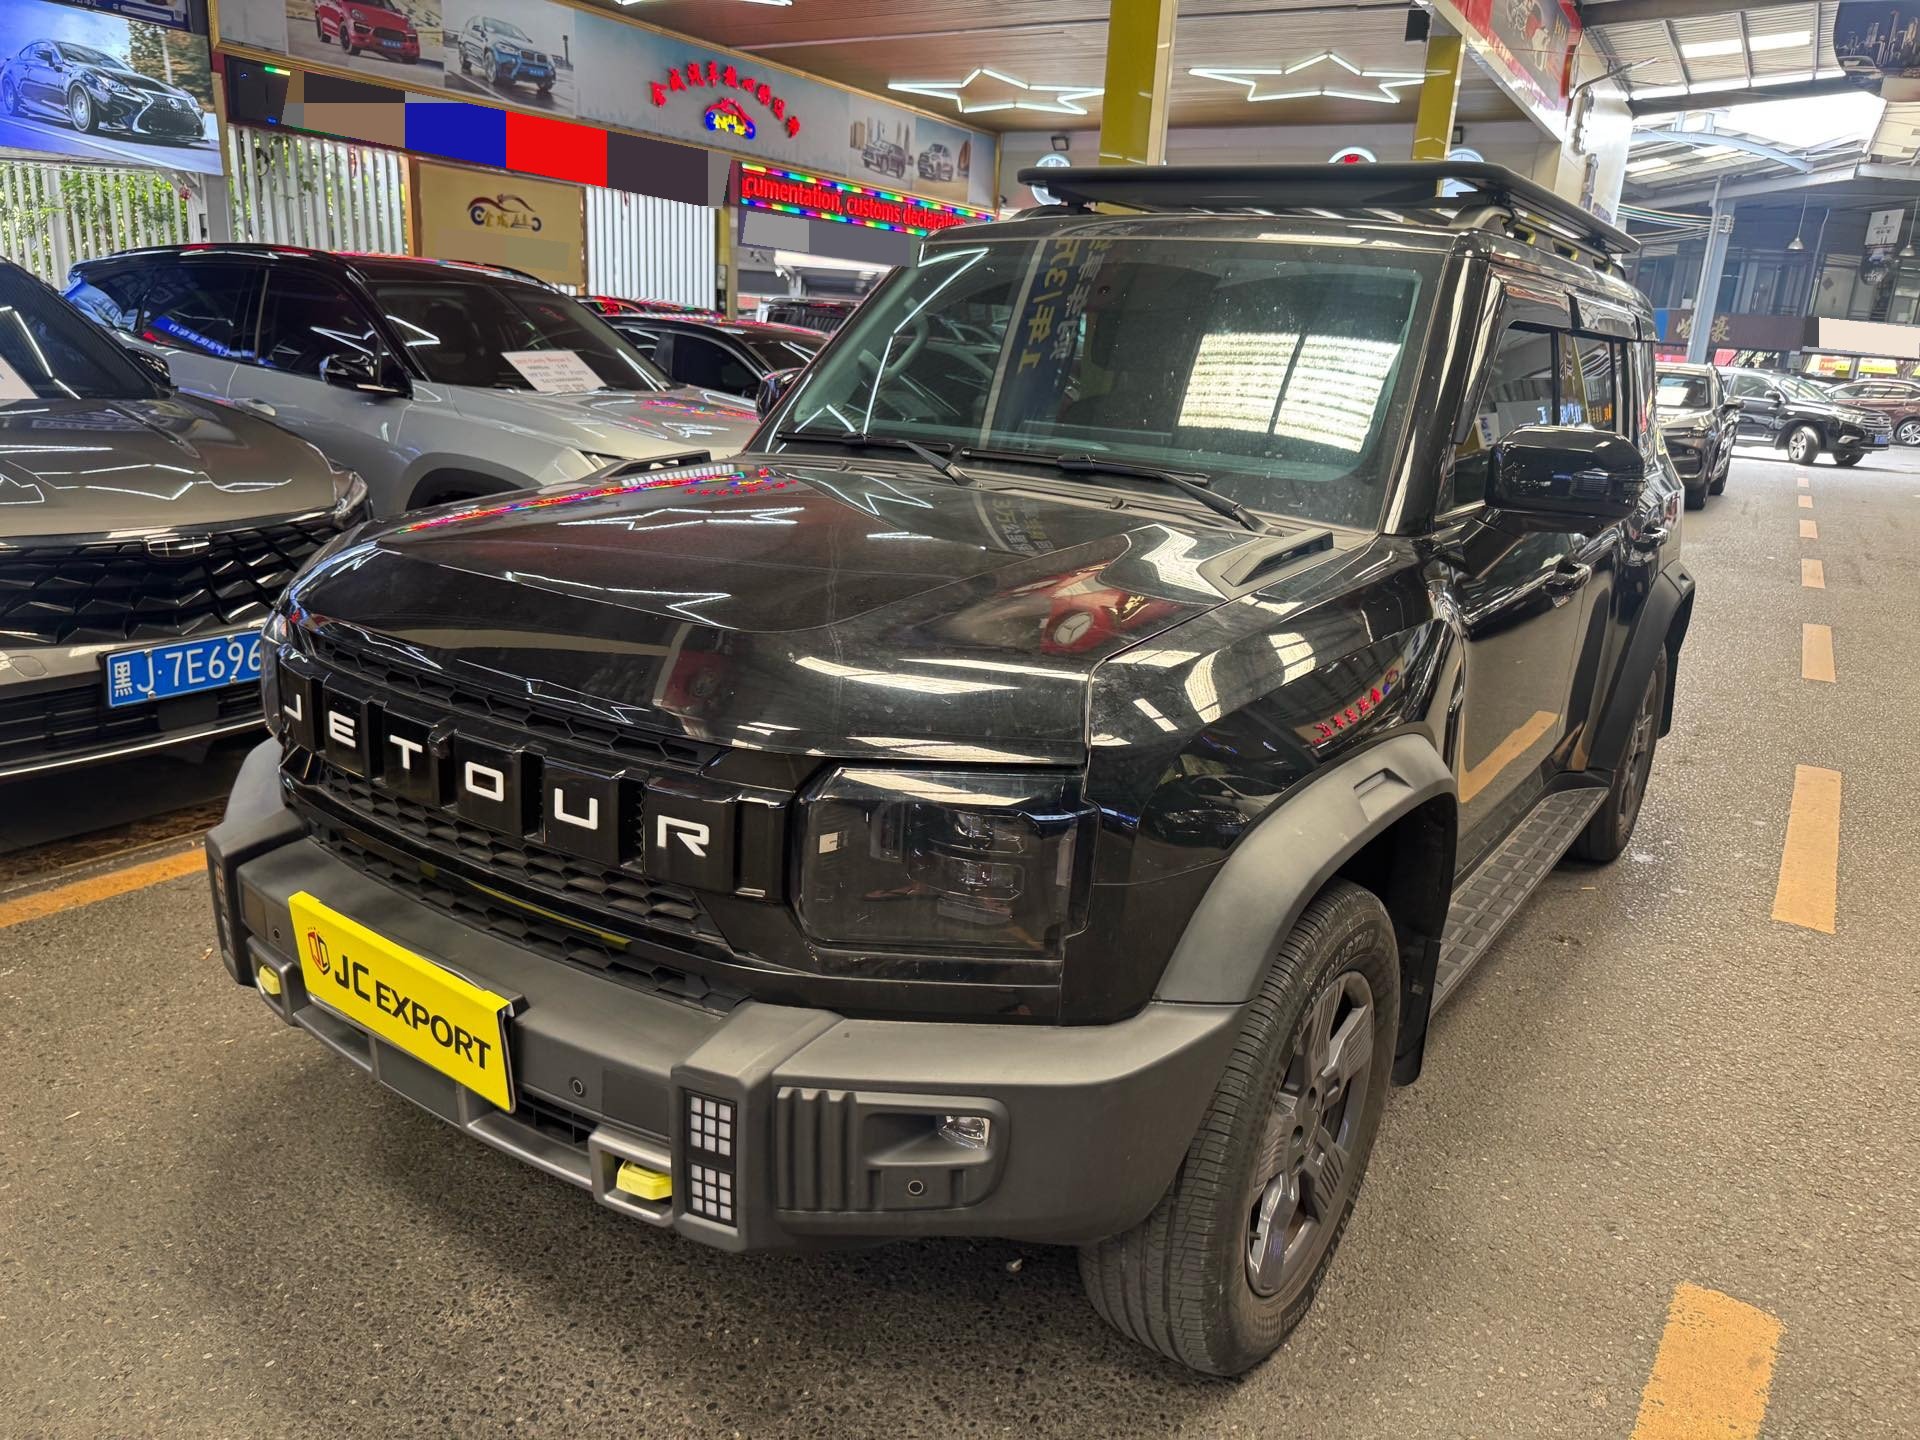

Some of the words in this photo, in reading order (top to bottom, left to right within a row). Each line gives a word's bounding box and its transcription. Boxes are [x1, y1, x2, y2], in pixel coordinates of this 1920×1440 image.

[847, 196, 900, 223] customs
[284, 694, 711, 858] JETOUR
[335, 954, 370, 1004] JC
[376, 986, 492, 1070] EXPORT
